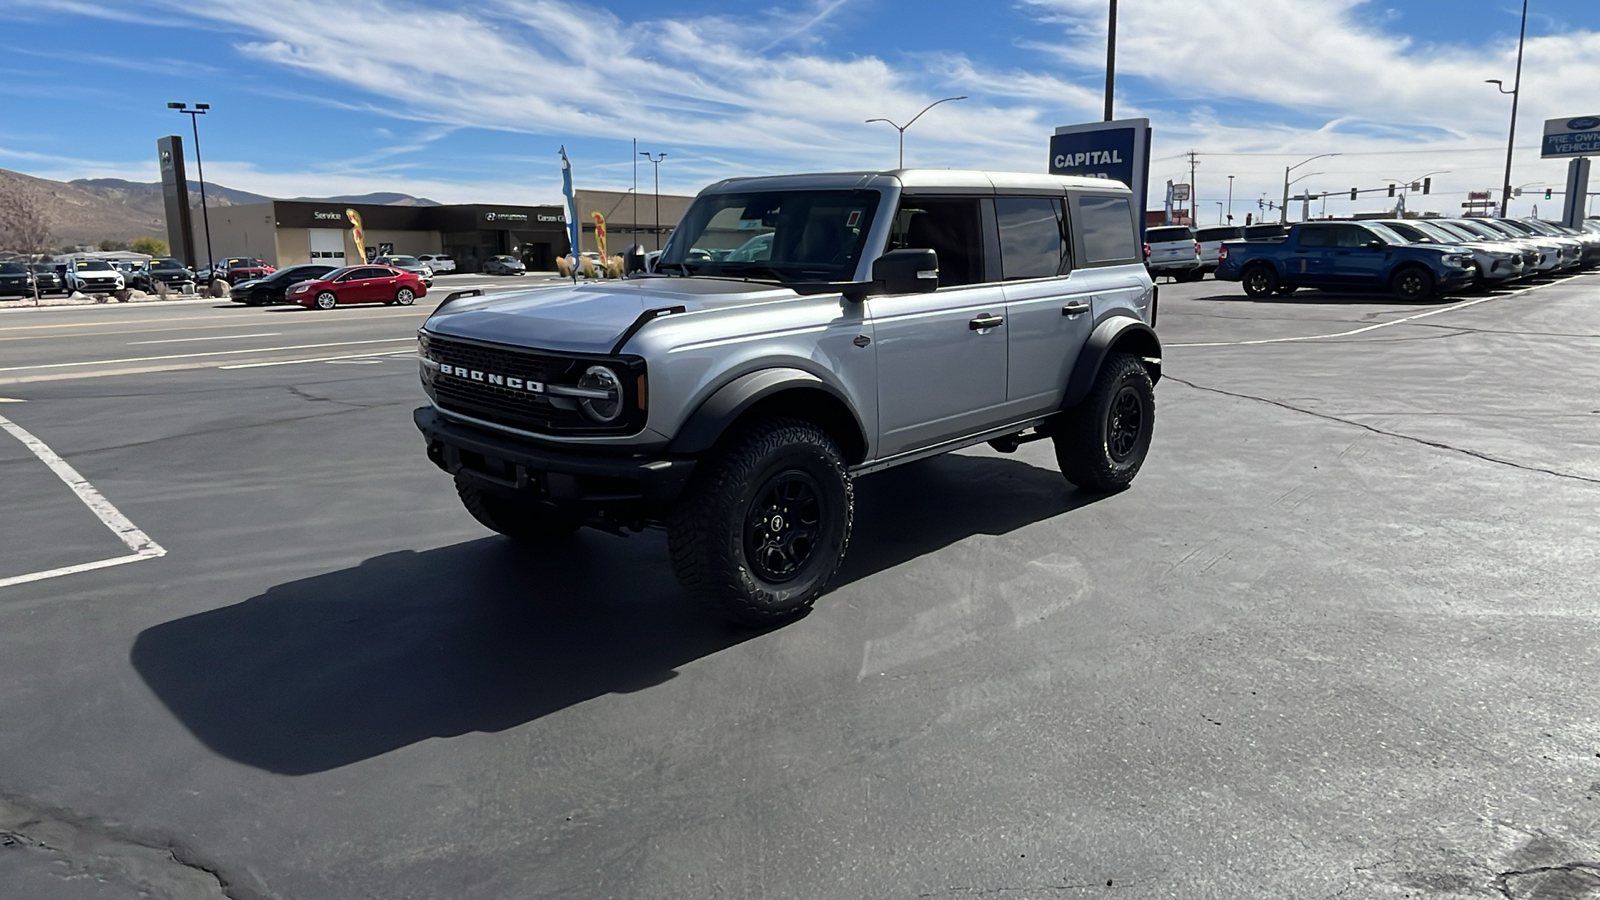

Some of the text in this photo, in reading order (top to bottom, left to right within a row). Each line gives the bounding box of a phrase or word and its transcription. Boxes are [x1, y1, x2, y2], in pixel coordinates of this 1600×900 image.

[1054, 150, 1123, 168] CAPITAL
[314, 211, 342, 220] Service
[440, 363, 545, 393] BRONCO
